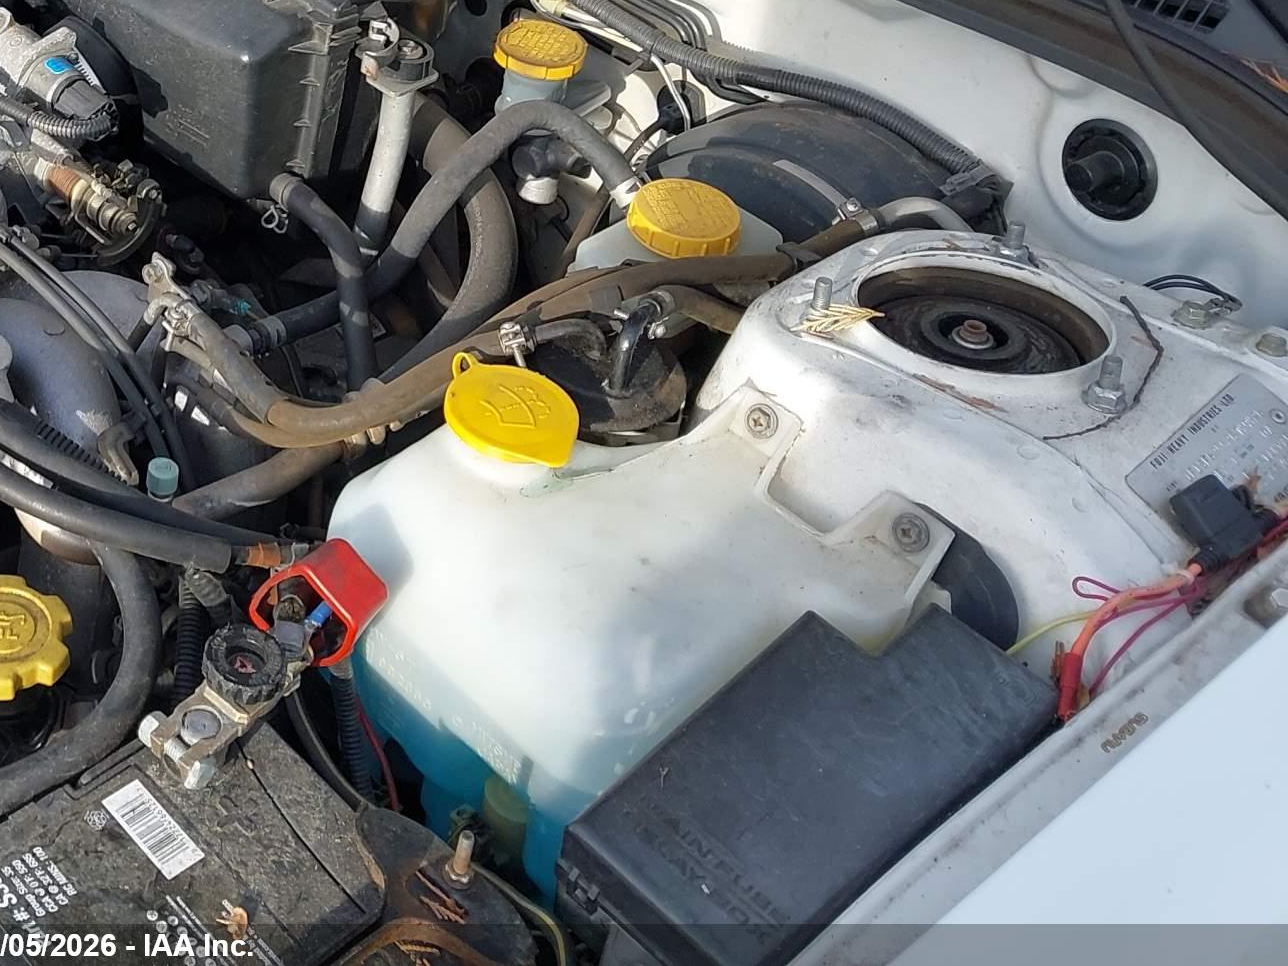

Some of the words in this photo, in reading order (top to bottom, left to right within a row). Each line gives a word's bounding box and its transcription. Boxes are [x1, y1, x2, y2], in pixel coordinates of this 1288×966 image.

[1149, 451, 1168, 470] FUJI
[1166, 432, 1189, 454] HEAVY
[1187, 403, 1222, 436] INDUSTRIES
[32, 844, 49, 861] 100
[9, 874, 30, 896] Size:
[61, 881, 77, 896] RC
[23, 892, 46, 917] Group
[39, 894, 58, 913] CCA
[54, 891, 69, 906] CA
